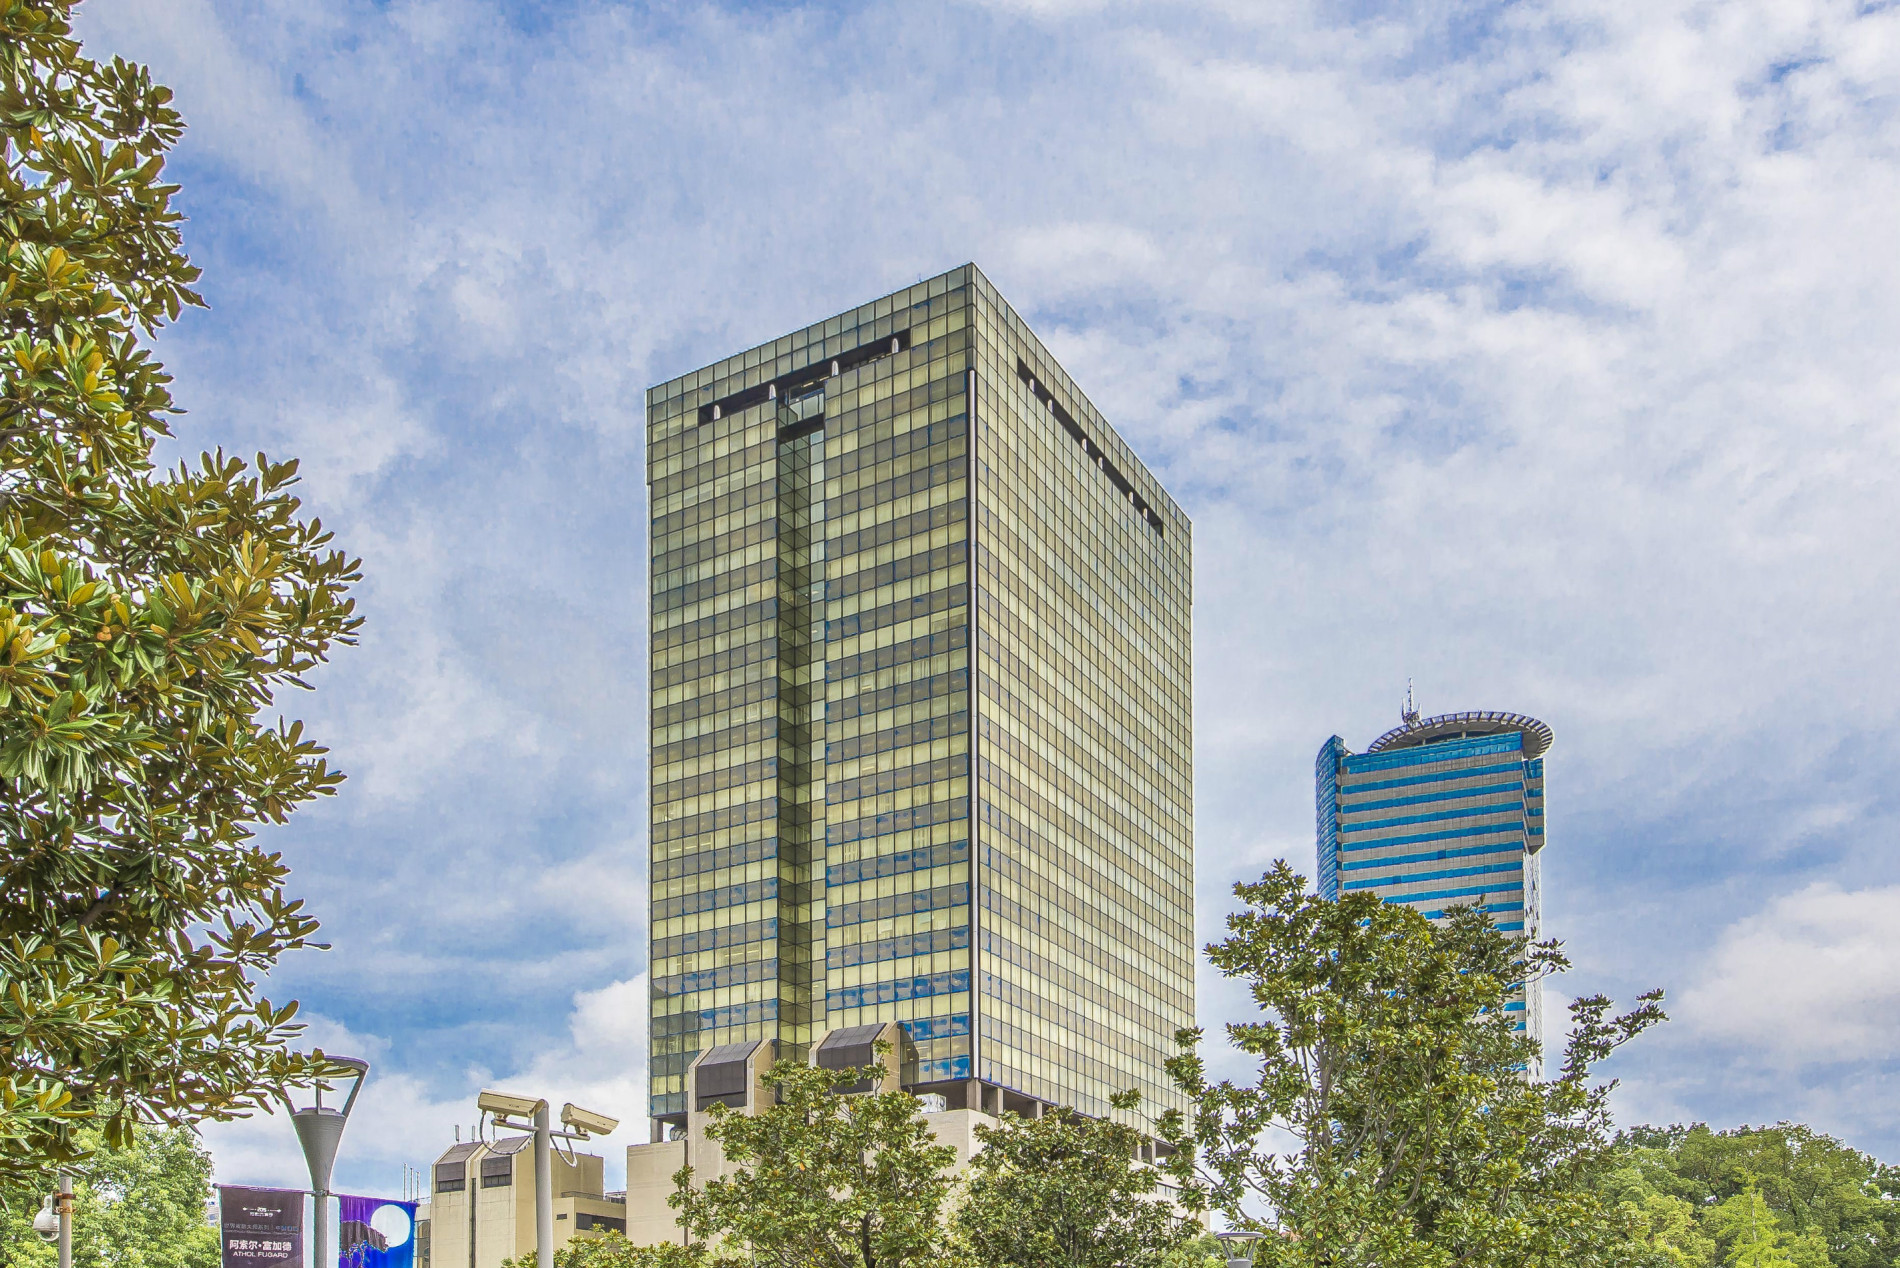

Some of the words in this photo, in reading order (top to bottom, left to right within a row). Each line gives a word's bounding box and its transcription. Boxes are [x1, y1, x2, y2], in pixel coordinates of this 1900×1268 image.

[229, 1239, 292, 1252] 阿索尔·富加德
